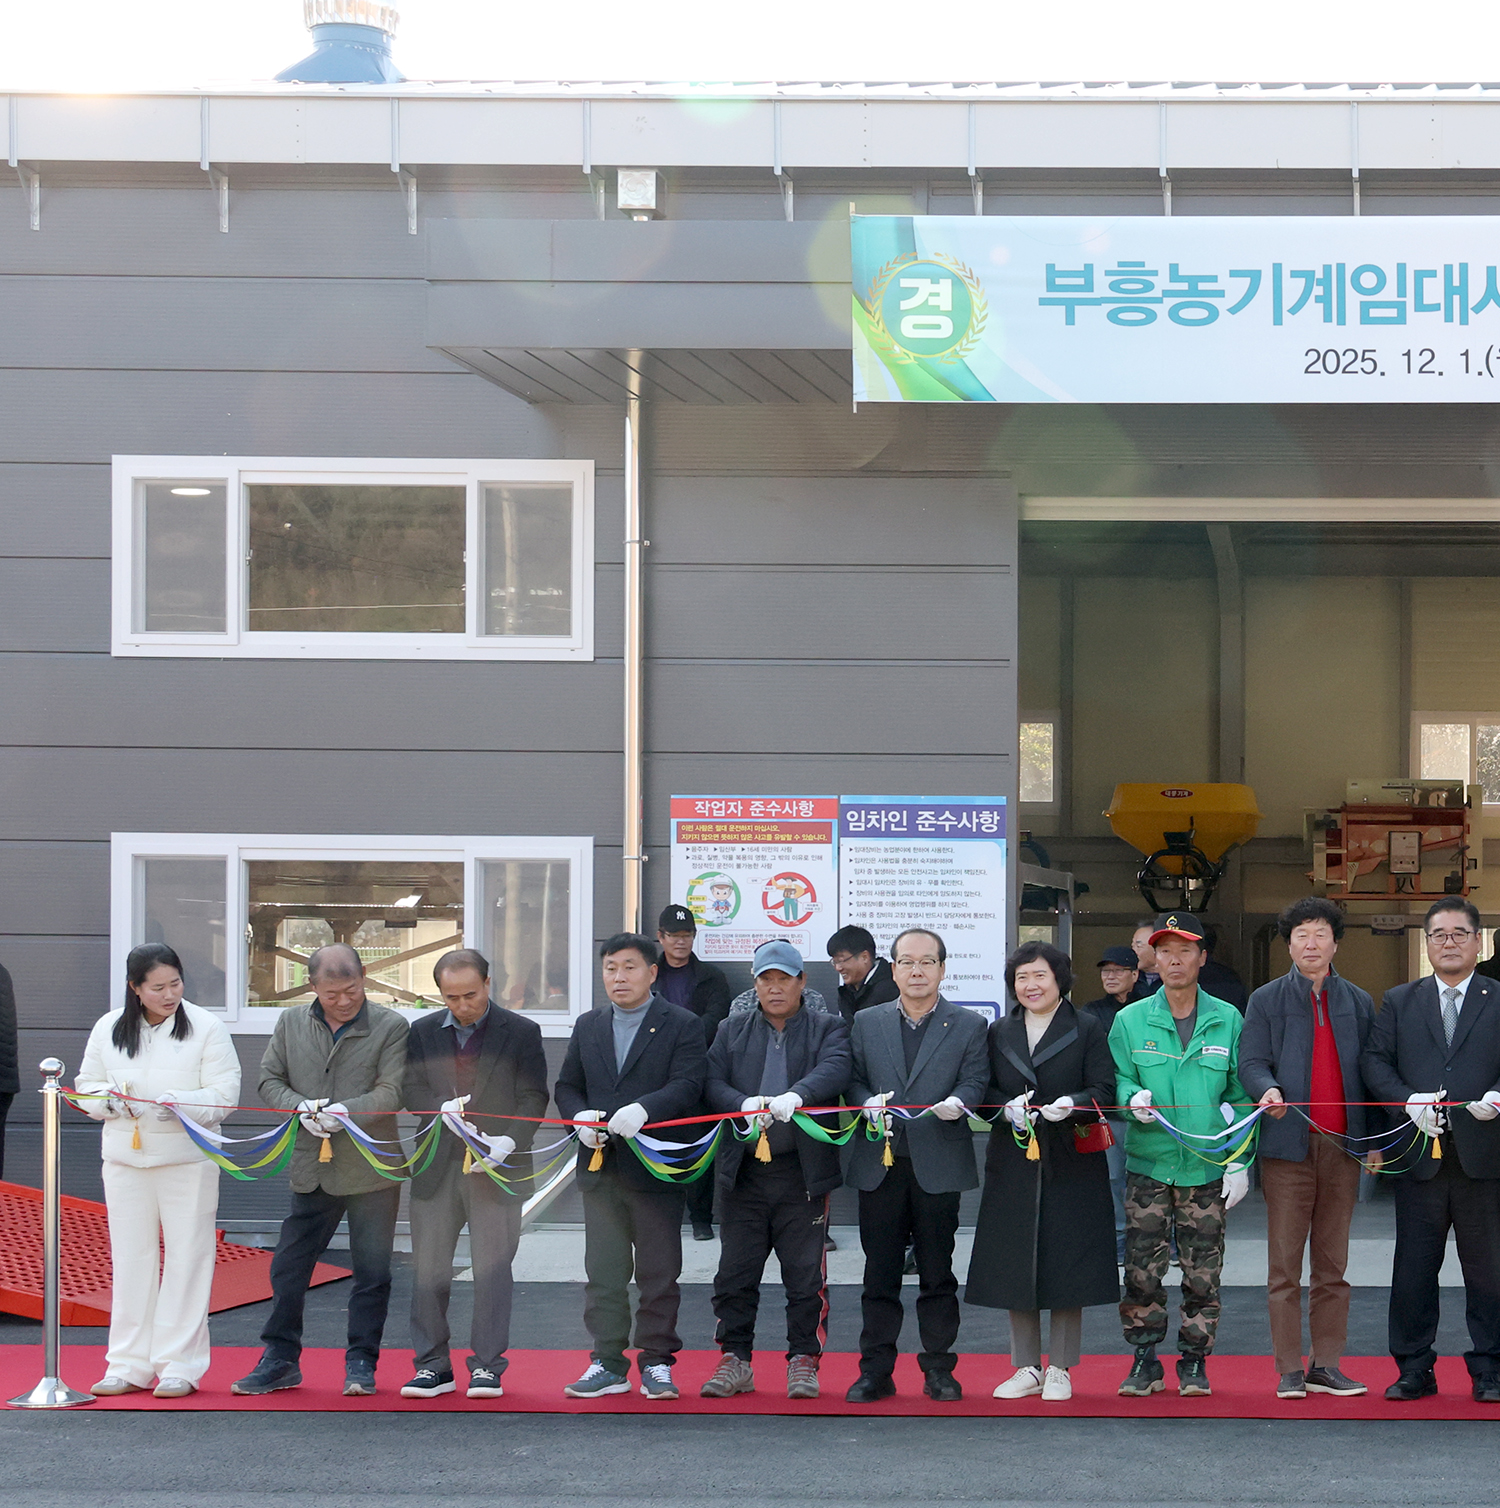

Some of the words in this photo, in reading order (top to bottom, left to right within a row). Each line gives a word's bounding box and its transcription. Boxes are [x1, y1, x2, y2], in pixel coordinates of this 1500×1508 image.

[900, 278, 953, 338] 경
[1304, 349, 1385, 376] 2025.
[1402, 348, 1443, 376] 12.
[695, 801, 743, 817] 작업자
[749, 801, 814, 817] 준수사항
[847, 810, 907, 831] 임차인
[916, 811, 1000, 832] 준수사항
